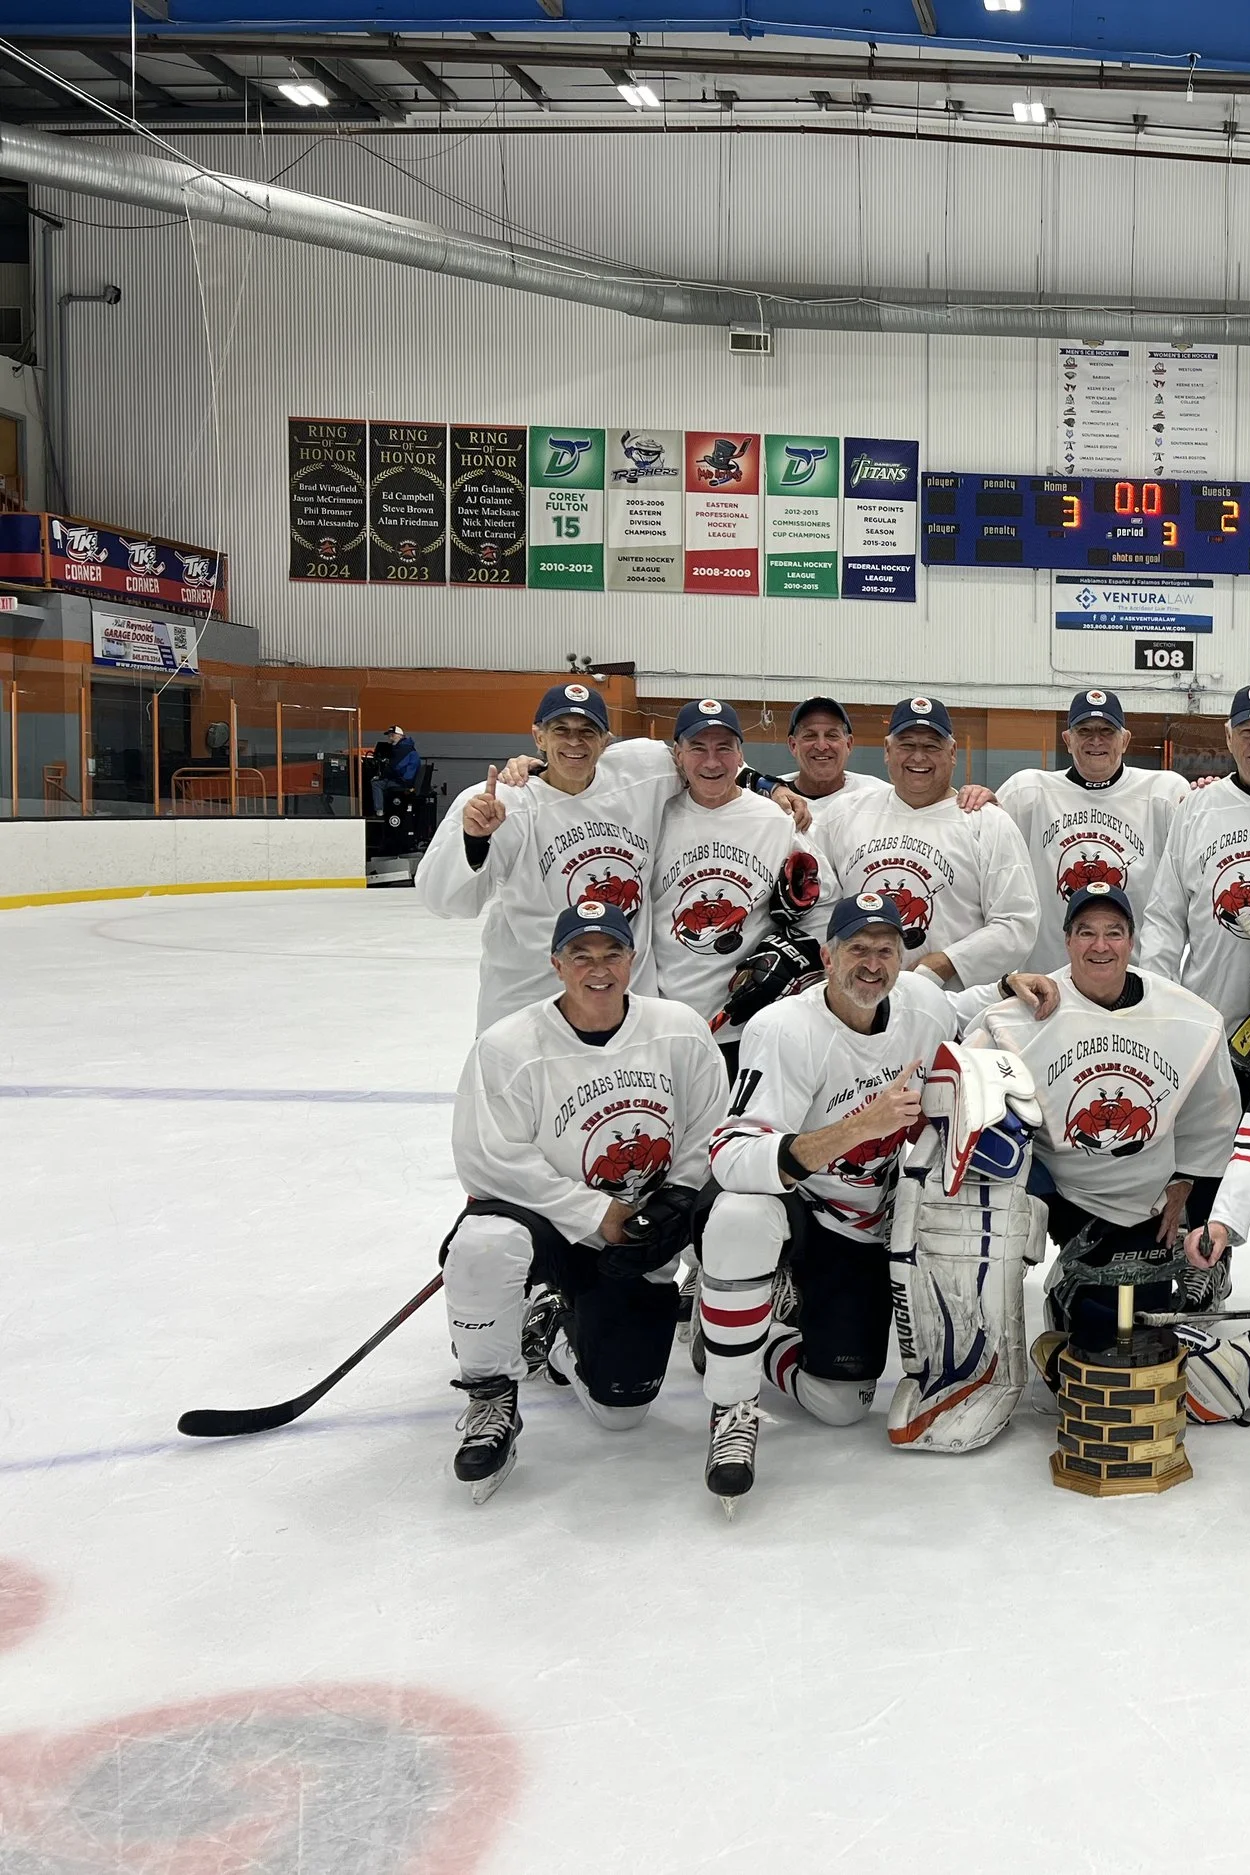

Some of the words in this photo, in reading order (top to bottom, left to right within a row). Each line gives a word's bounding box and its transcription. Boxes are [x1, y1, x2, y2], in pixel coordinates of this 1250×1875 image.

[308, 426, 347, 438] RING
[389, 429, 428, 441] RING
[322, 440, 334, 448] OF
[469, 432, 508, 445] RING
[402, 443, 414, 451] OF
[482, 445, 495, 453] OF
[300, 449, 356, 462] HONOR
[380, 452, 436, 465] HONOR
[461, 454, 517, 468] HONOR
[851, 453, 911, 488] TITANS
[463, 484, 479, 493] Jim
[481, 485, 514, 494] Galante
[927, 477, 955, 489] player
[983, 478, 1016, 491] penalty
[1044, 481, 1068, 492] Home
[549, 492, 586, 501] COREY
[1201, 485, 1231, 497] Guests
[382, 492, 392, 500] Ed
[394, 492, 434, 503] Campbell
[465, 496, 477, 505] AJ
[480, 496, 512, 506] Galante
[1114, 482, 1161, 515] 0.0
[382, 504, 405, 513] Steve
[407, 506, 434, 514] Brown
[458, 506, 478, 515] Dave
[546, 502, 588, 512] FULTON
[1062, 495, 1081, 528] 3
[695, 511, 749, 519] PROFESSIONAL
[1220, 500, 1240, 533] 2
[378, 517, 398, 526] Alan
[400, 518, 439, 527] Friedman
[552, 516, 580, 538] 15
[707, 521, 737, 529] HOCKEY
[772, 520, 830, 528] COMMISSIONERS
[928, 523, 956, 535] player
[984, 524, 1016, 537] penalty
[1116, 527, 1144, 538] period
[1162, 521, 1178, 546] 3
[788, 532, 830, 540] CHAMPIONS
[863, 539, 897, 547] 2015-2016
[646, 556, 675, 564] HOCKEY
[770, 560, 802, 568] FEDERAL
[804, 561, 832, 569] HOCKEY
[1112, 552, 1133, 563] shots
[1135, 554, 1144, 562] on
[1145, 553, 1160, 565] goal
[65, 564, 102, 582] CORNER
[307, 563, 350, 578] 2024
[387, 566, 429, 581] 2023
[539, 563, 593, 573] 2010-2012
[693, 567, 751, 578] 2008-2009
[848, 563, 880, 571] FEDERAL
[882, 564, 911, 572] HOCKEY
[467, 568, 510, 583] 2022
[626, 575, 666, 583] 2004-2006
[865, 574, 893, 582] LEAGUE
[126, 577, 160, 593] CORNER
[861, 585, 896, 593] 2015-2017
[181, 588, 212, 604] CORNER
[126, 621, 154, 632] Reynolds
[104, 628, 131, 640] GARAGE
[132, 633, 153, 644] DOORS
[154, 635, 164, 644] Inc.
[1144, 649, 1185, 667] 108
[1086, 780, 1110, 788] CCM
[1048, 1052, 1073, 1088] OLDE
[1076, 1036, 1108, 1061] CRABS
[1112, 1033, 1151, 1064] HOCKEY
[1152, 1052, 1180, 1090] CLUB
[1072, 1068, 1093, 1085] THE
[1094, 1063, 1122, 1075] OLDE
[1122, 1065, 1155, 1088] CRABS
[1112, 1248, 1167, 1262] BAUER
[452, 1319, 496, 1331] CCM
[891, 1280, 917, 1358] VAUGHN
